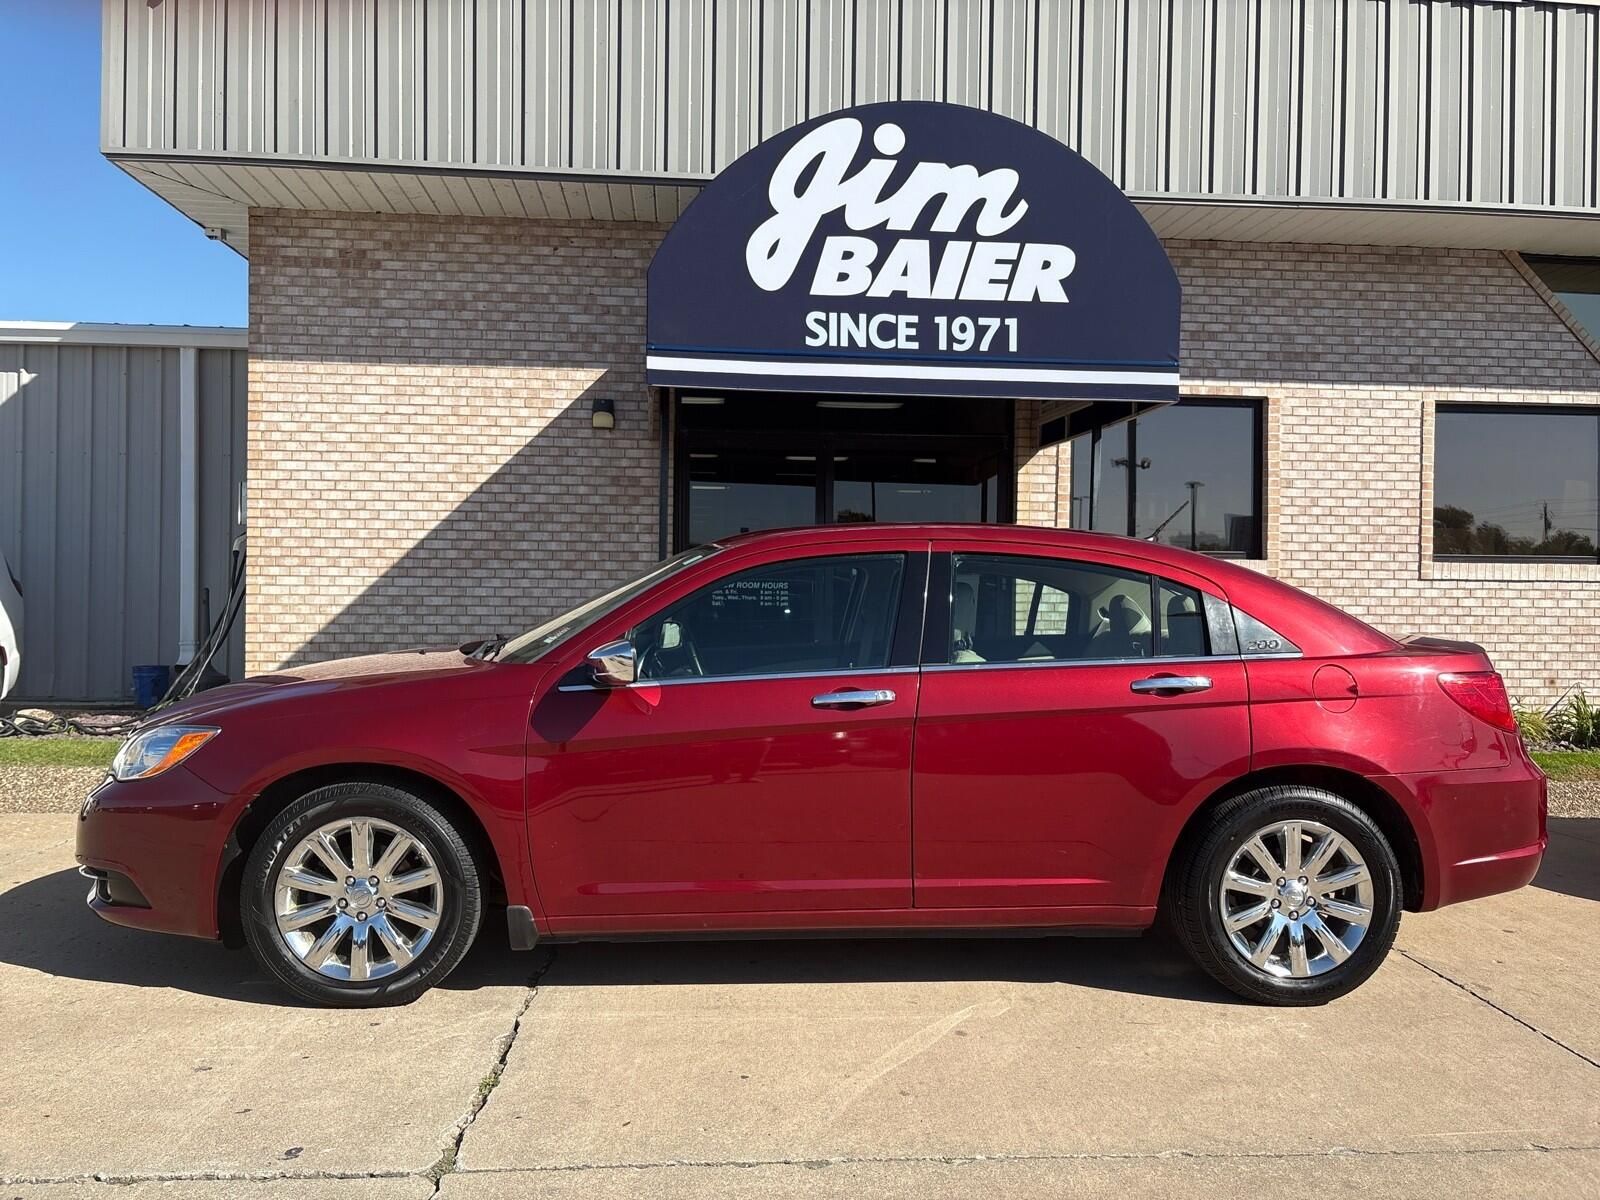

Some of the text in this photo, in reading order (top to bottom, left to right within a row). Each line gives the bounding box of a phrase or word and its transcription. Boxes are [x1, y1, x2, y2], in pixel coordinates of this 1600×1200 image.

[746, 117, 1029, 292] Jim
[810, 235, 1077, 304] BAIER
[805, 310, 1018, 352] SINCE 1971
[1246, 639, 1280, 651] 200
